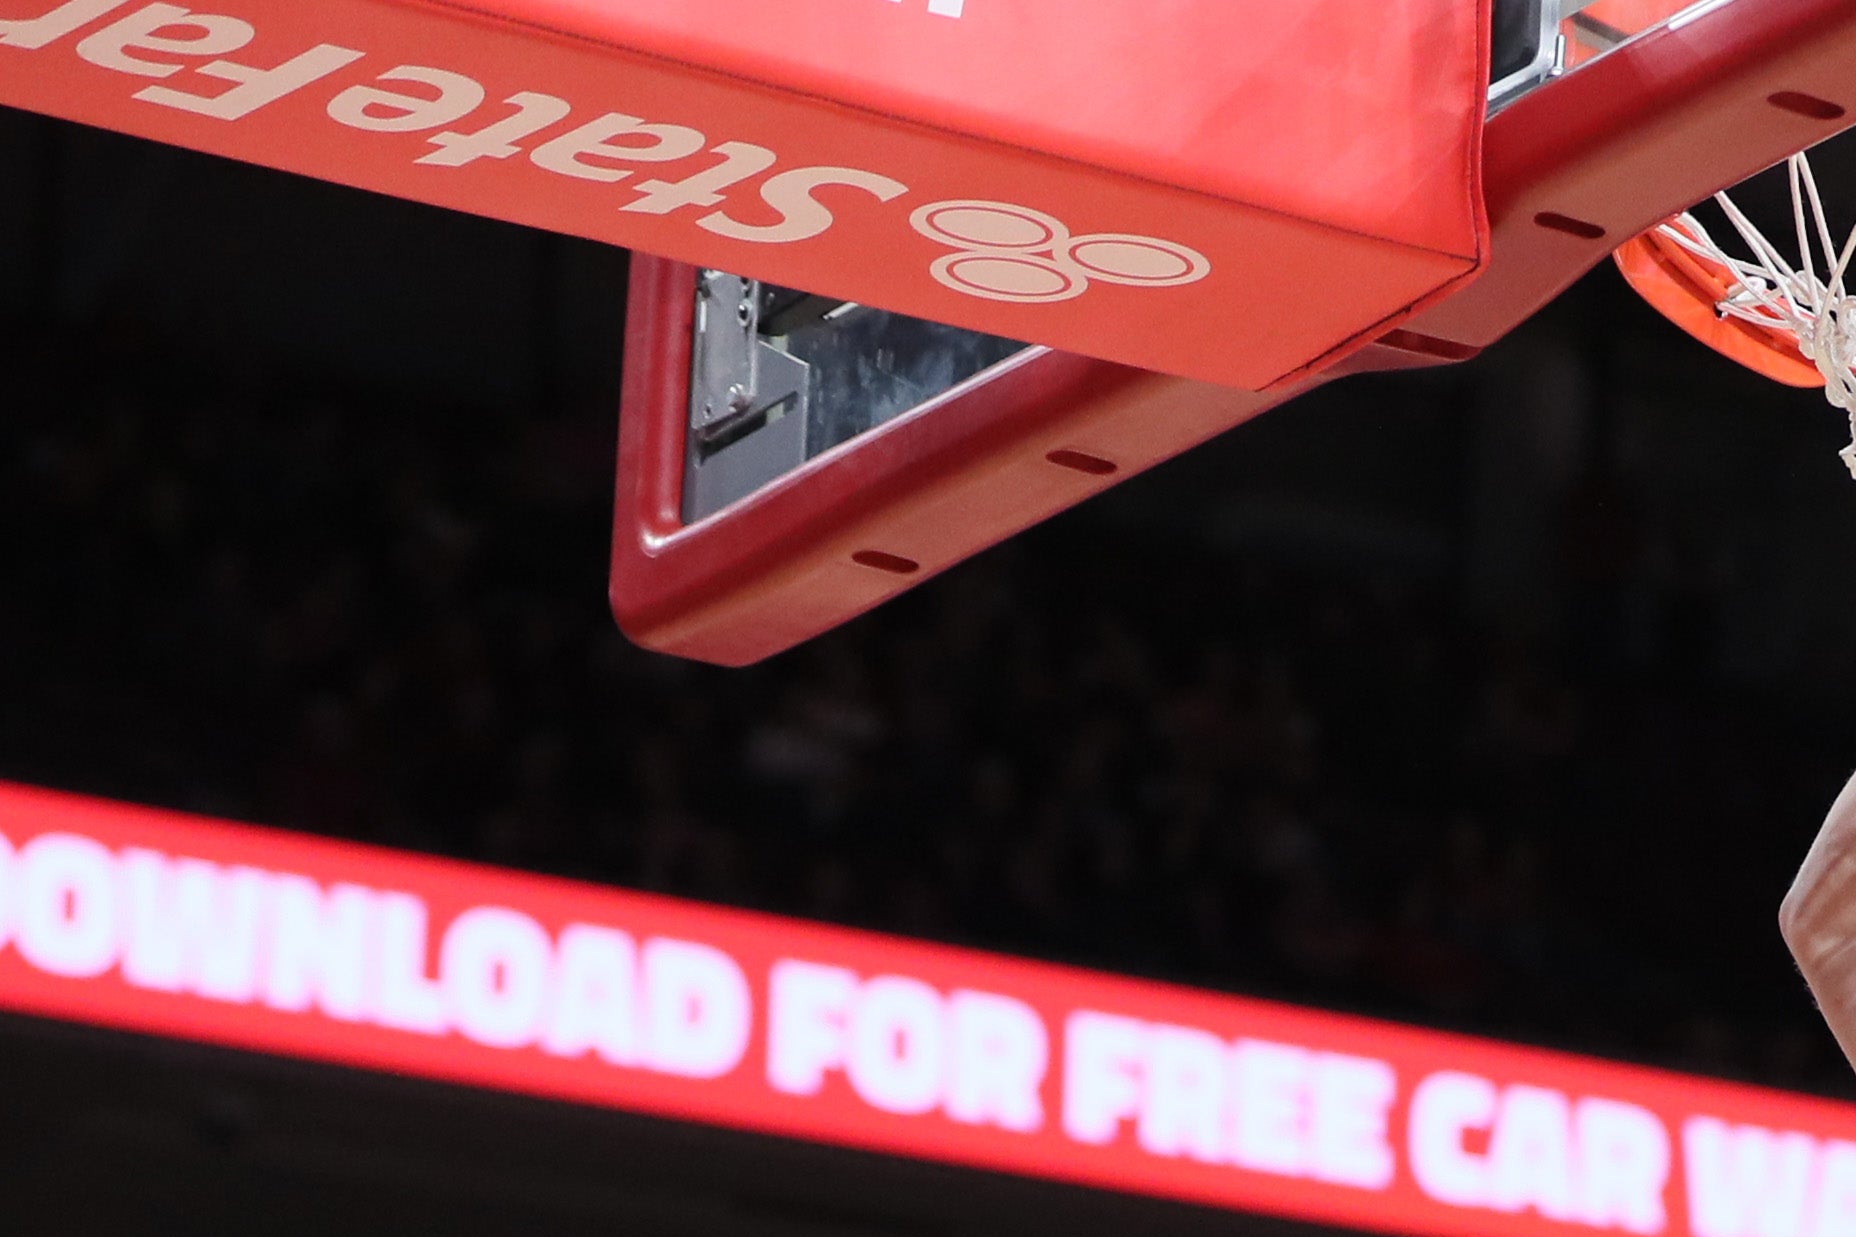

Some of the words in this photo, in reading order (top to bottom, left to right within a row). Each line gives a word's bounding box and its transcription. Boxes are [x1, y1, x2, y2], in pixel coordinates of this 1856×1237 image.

[0, 833, 753, 1079] OWNLOAD
[767, 959, 1050, 1134] FOR
[1062, 1010, 1398, 1191] FREE
[1407, 1071, 1673, 1237] CAR
